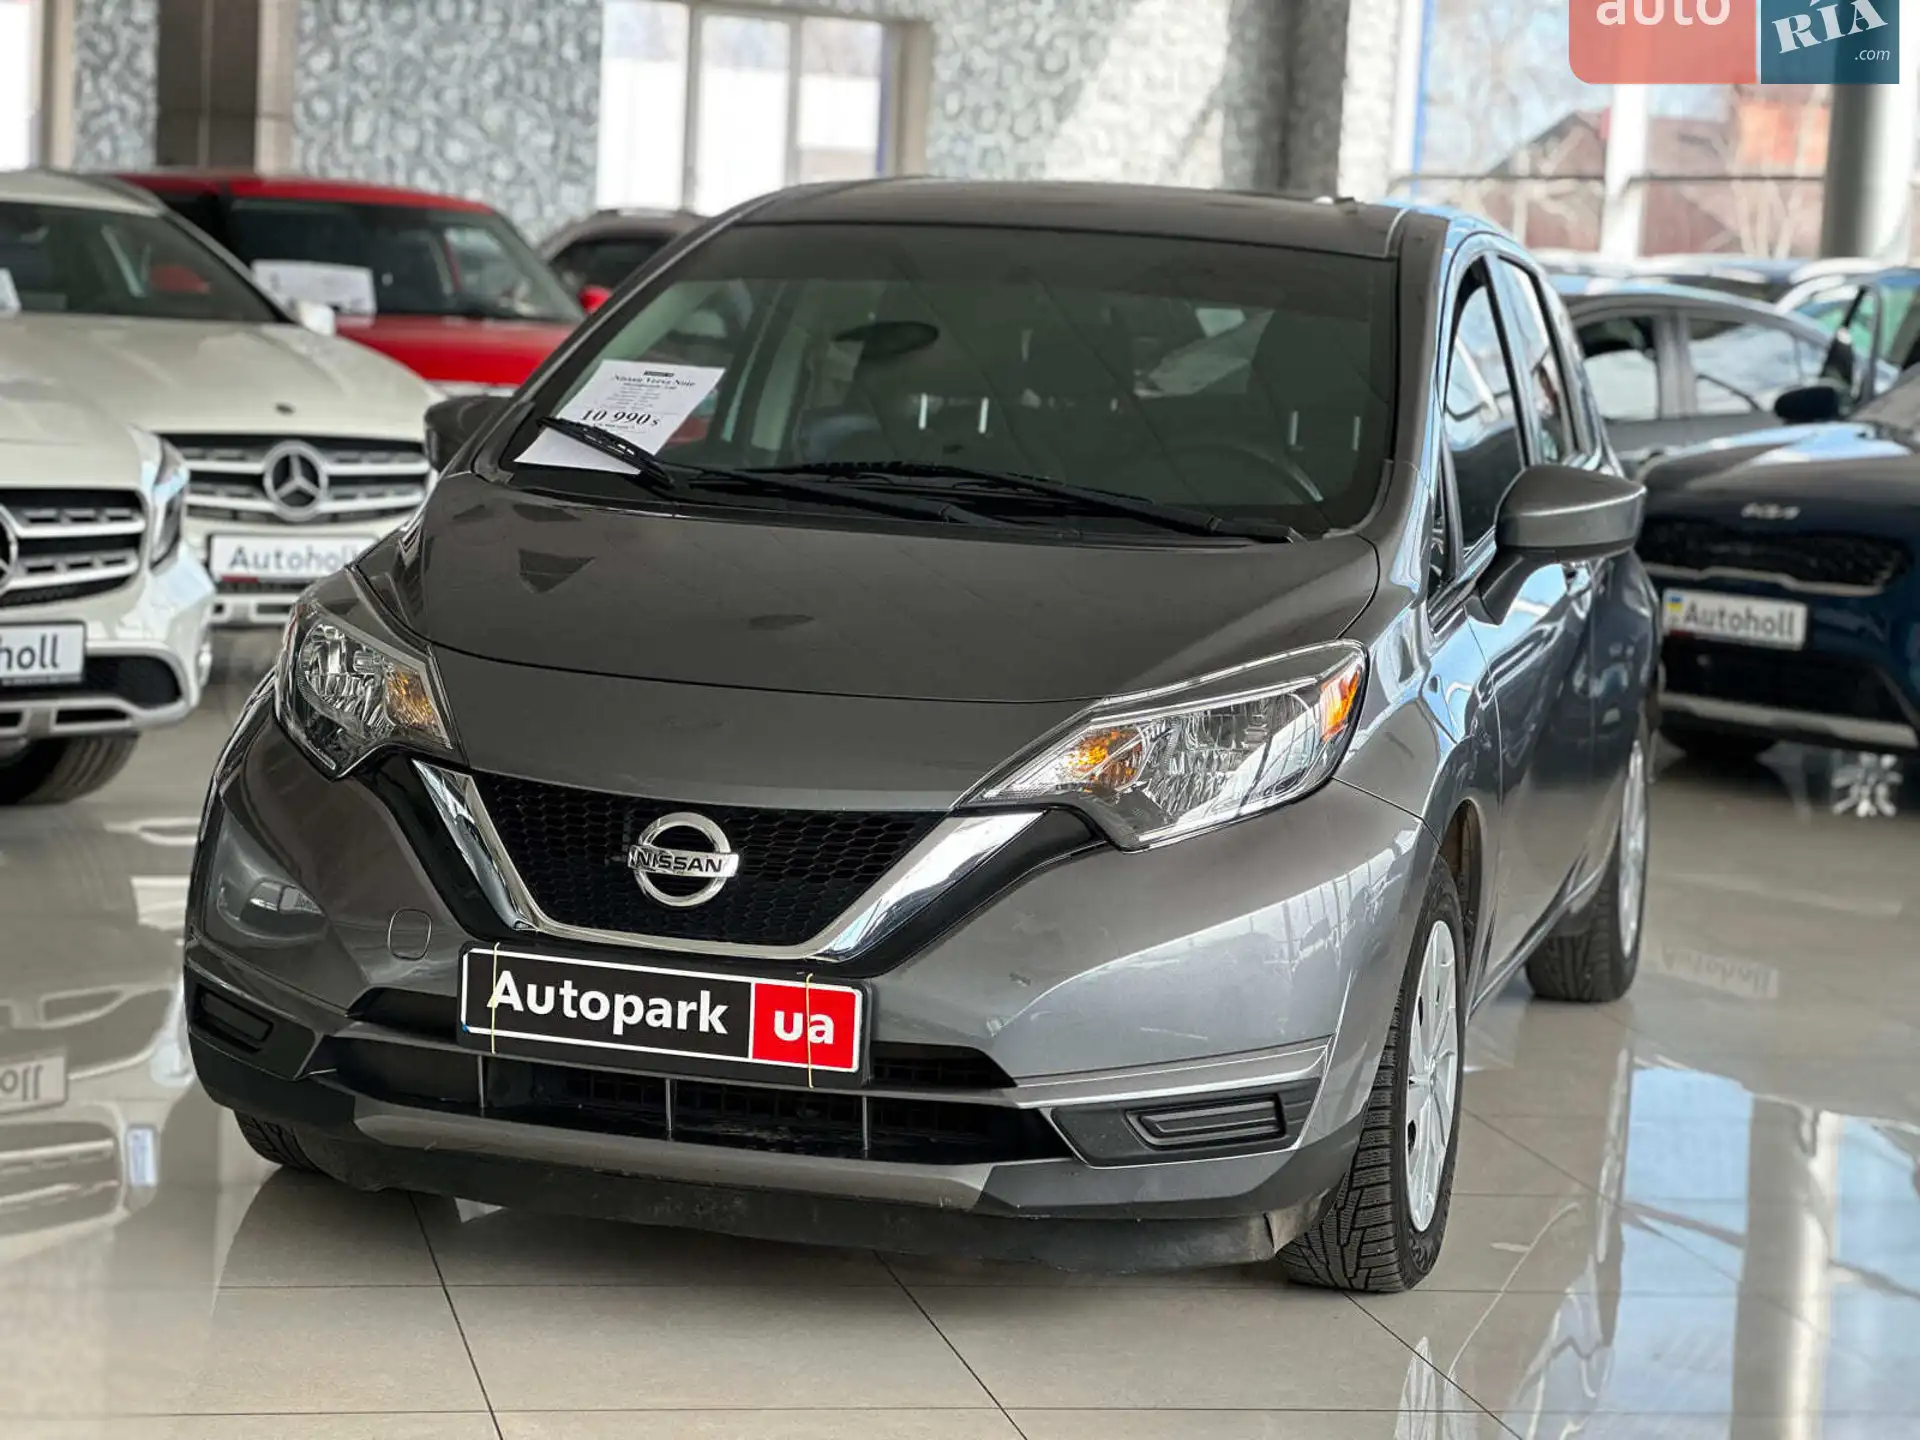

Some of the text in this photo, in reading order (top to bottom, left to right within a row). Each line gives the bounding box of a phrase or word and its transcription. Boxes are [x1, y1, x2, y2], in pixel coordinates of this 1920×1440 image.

[581, 408, 607, 421] 10
[1684, 600, 1794, 637] Autoholl
[636, 848, 723, 873] NISSAN
[487, 969, 834, 1045] Autopark ua
